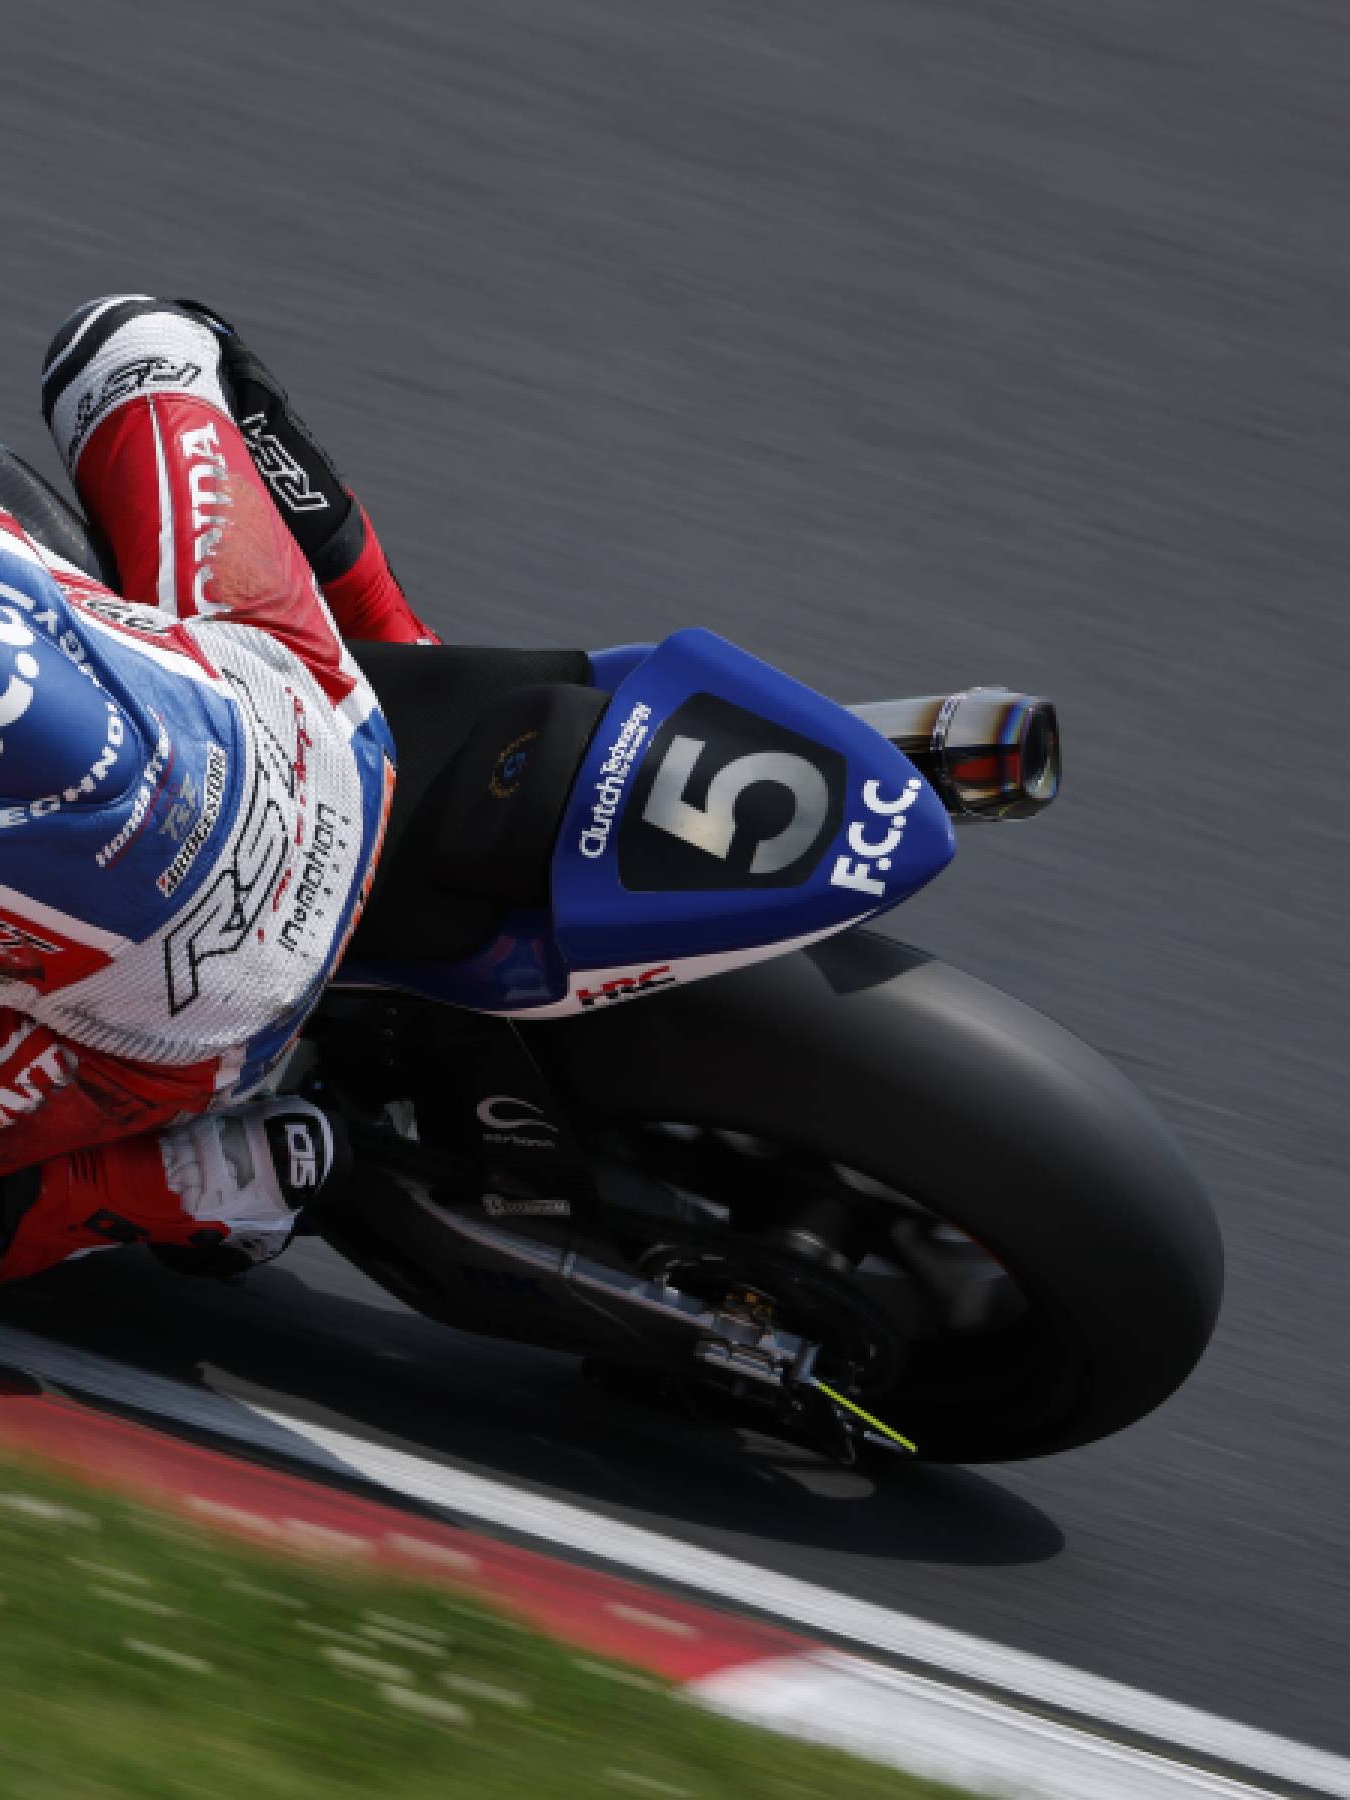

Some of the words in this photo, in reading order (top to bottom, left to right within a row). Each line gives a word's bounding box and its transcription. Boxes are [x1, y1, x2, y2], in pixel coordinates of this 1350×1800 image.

[579, 775, 625, 859] Clutch
[641, 734, 829, 874] 5
[830, 778, 922, 897] F.C.C.
